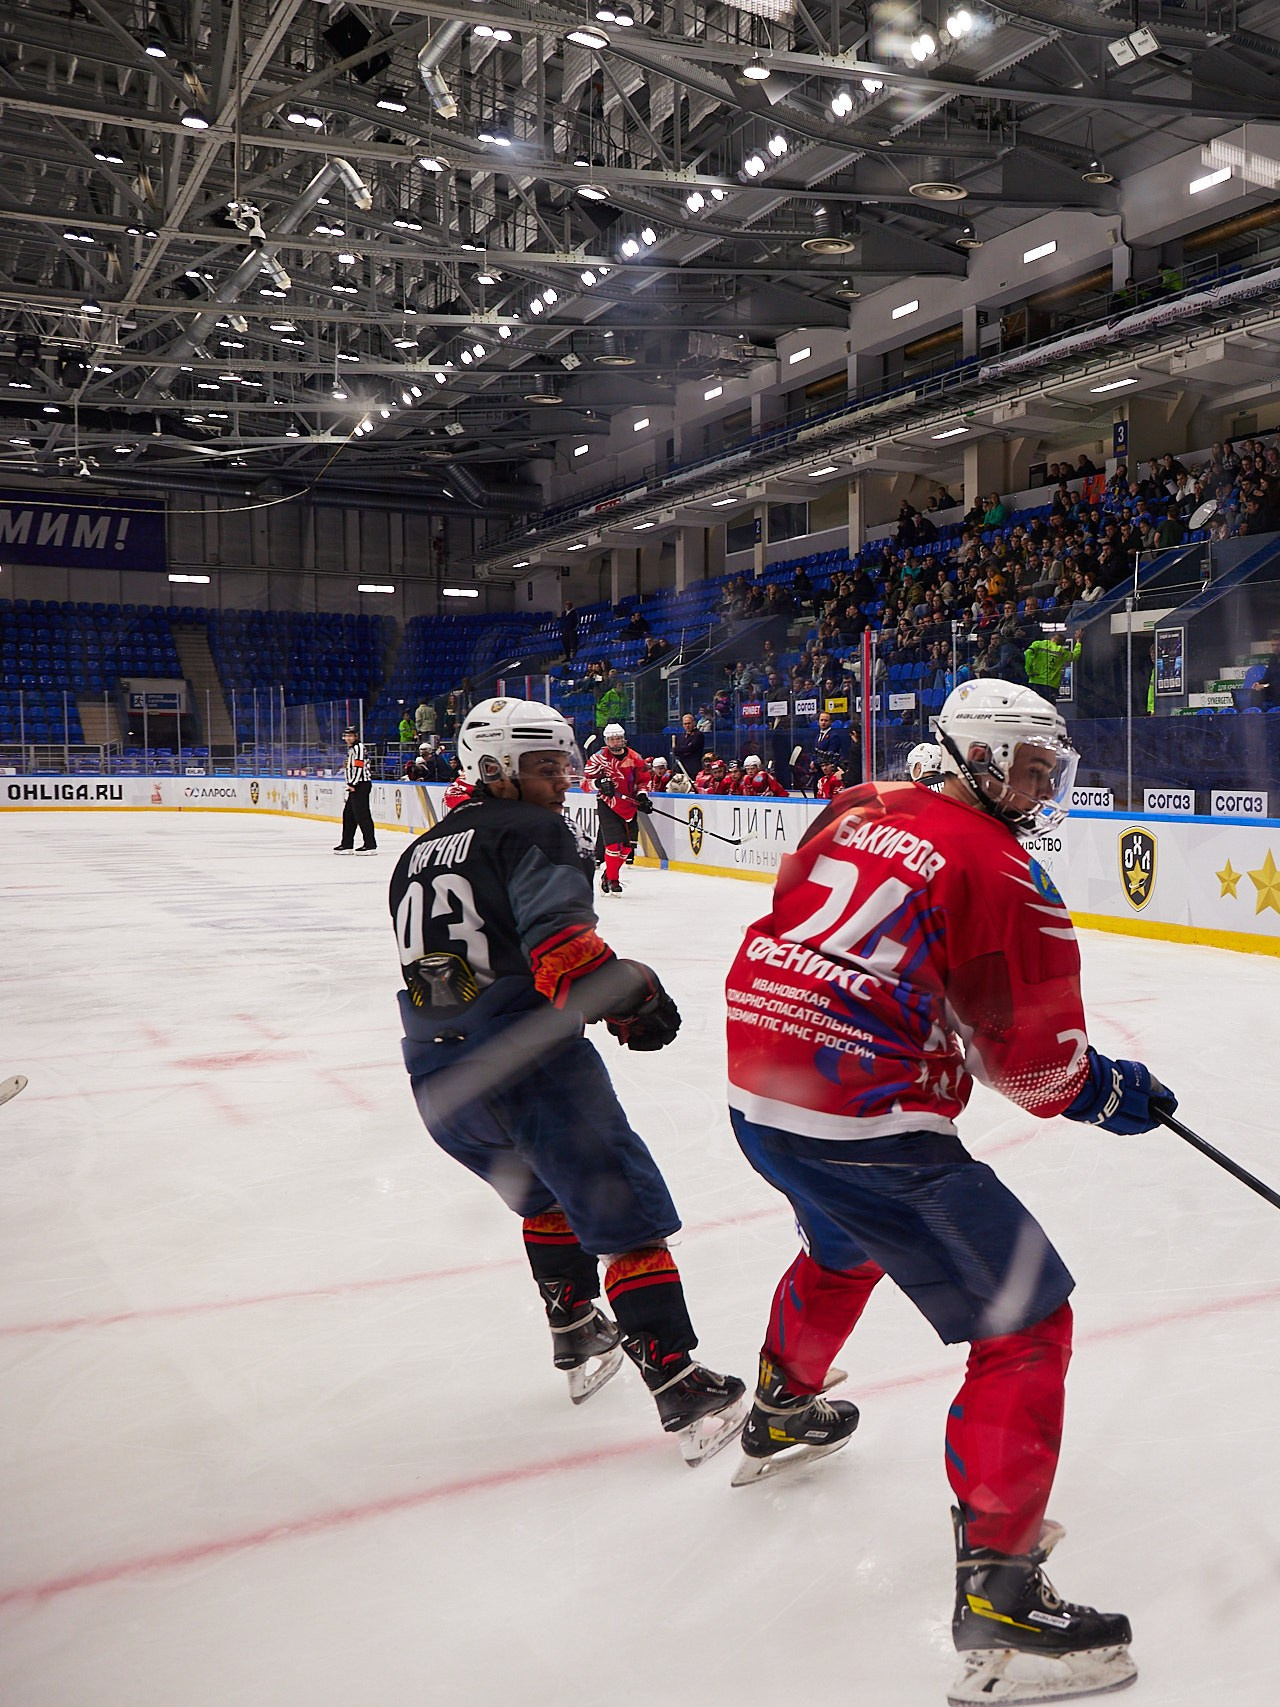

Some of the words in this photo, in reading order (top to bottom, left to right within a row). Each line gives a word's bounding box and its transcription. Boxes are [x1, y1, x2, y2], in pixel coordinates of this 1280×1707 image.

[1117, 426, 1124, 442] 3
[742, 705, 761, 715] FONBET
[960, 763, 978, 789] CCM
[8, 784, 123, 800] OHLIGA.RU
[731, 807, 786, 841] ЛИГА
[735, 848, 781, 867] СИЛЬНЫ
[832, 814, 947, 883] БАКИРОВ
[746, 936, 882, 1001] ФЕНИКС
[752, 978, 831, 1009] ИВАНОВСКАЯ
[782, 1021, 814, 1041] МЧС
[814, 1032, 877, 1060] РОССИИ
